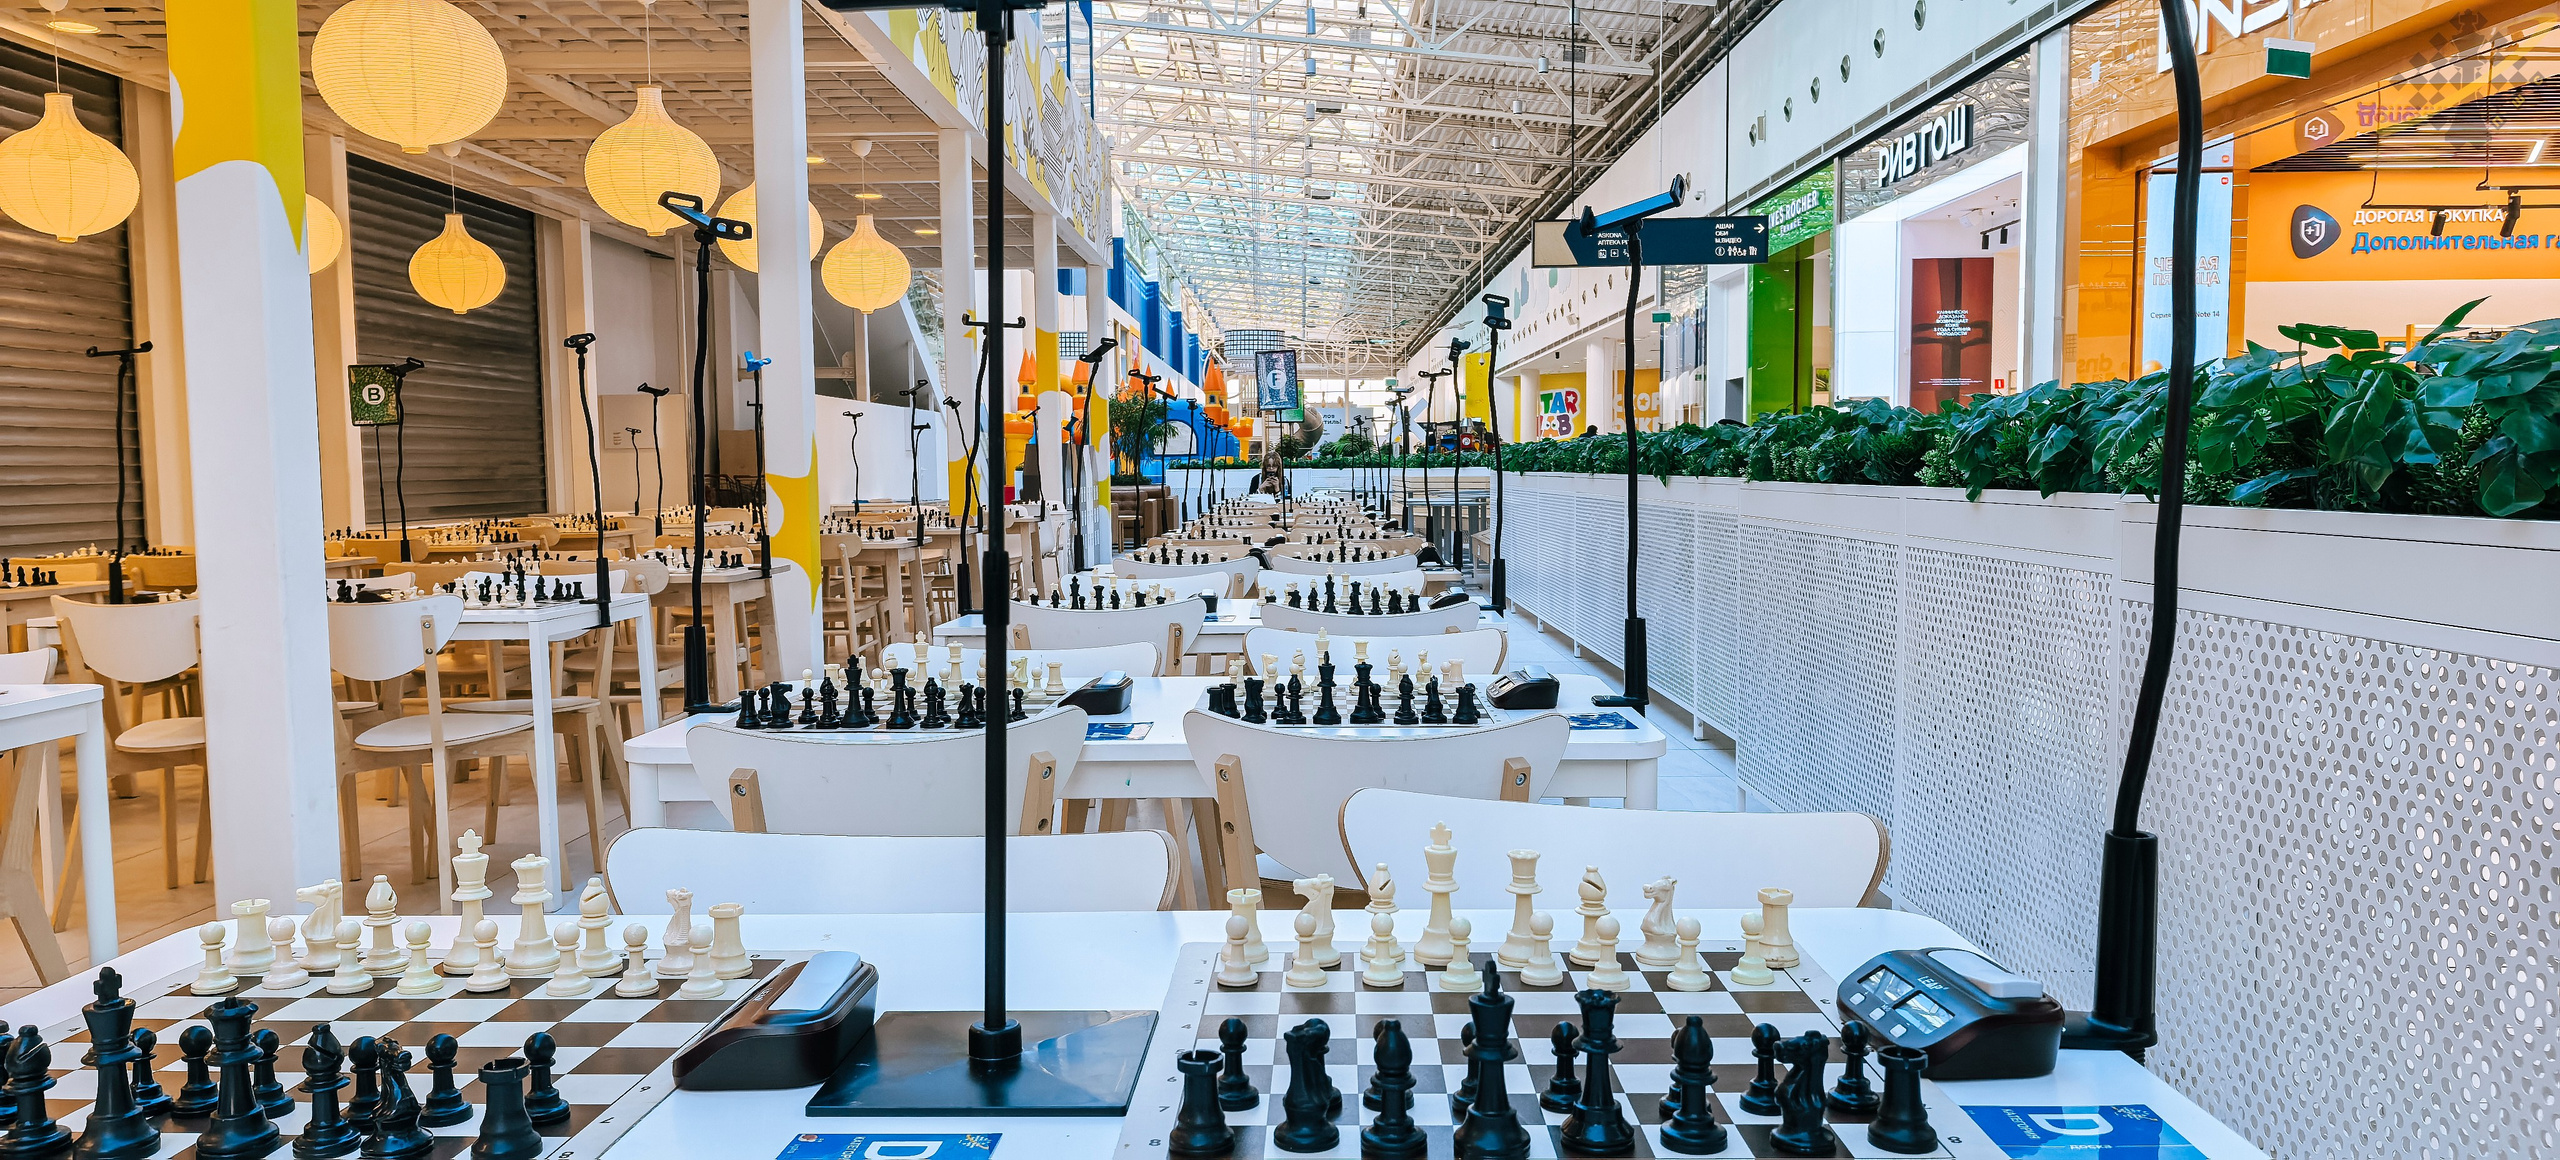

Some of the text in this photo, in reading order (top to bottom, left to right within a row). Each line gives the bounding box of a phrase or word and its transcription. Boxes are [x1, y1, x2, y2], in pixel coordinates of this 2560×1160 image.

[1878, 103, 1974, 188] РИВ ГОШ
[1786, 189, 1820, 220] ROCHER
[2353, 209, 2424, 225] ДОРОГАЯ
[2352, 232, 2560, 254] Дополнительная г
[2153, 256, 2220, 271] ЧЕАЯ
[2152, 272, 2220, 287] ПЯИЦА
[2150, 311, 2171, 319] Серия
[1540, 391, 1579, 414] TAR
[2001, 1108, 2041, 1141] КАТЕГОРИЯ
[2027, 1113, 2114, 1137] D
[1148, 1138, 1161, 1147] 8
[1947, 1135, 1962, 1144] 8
[863, 1140, 944, 1160] D
